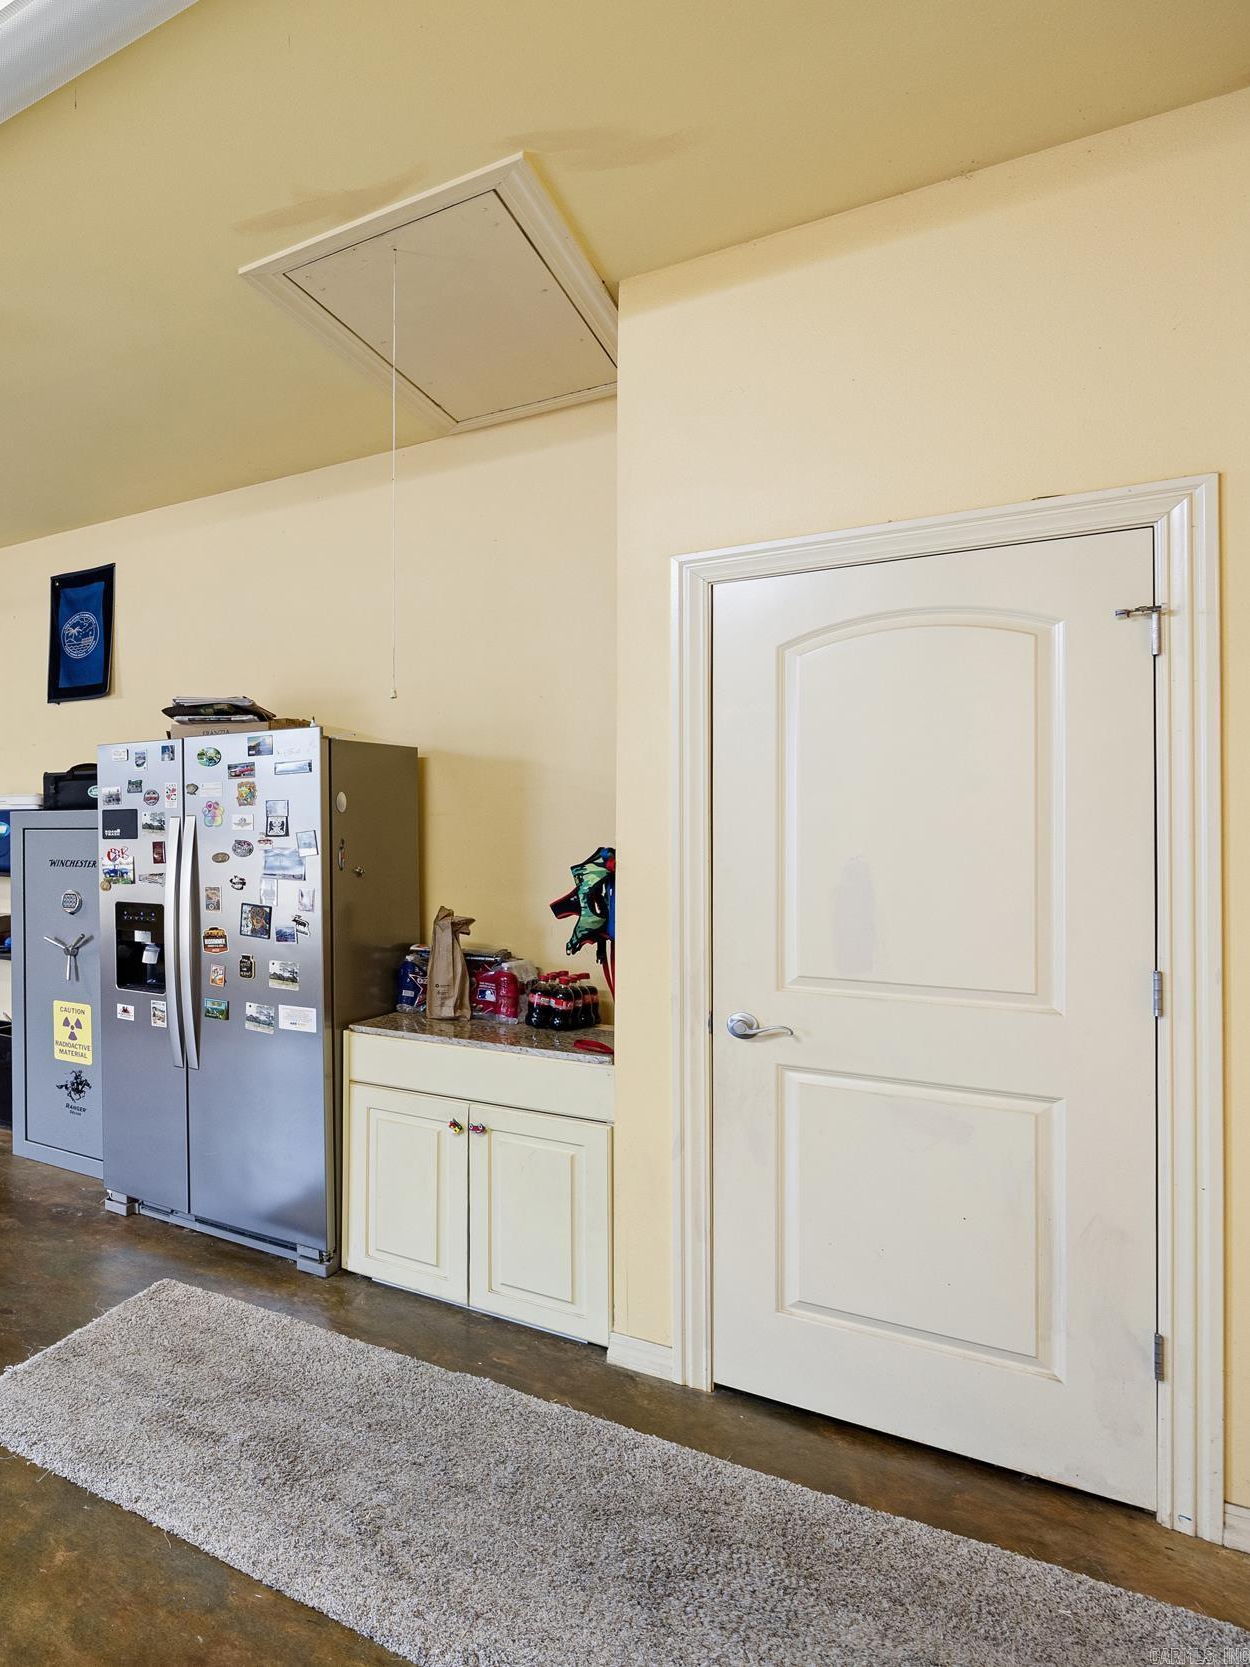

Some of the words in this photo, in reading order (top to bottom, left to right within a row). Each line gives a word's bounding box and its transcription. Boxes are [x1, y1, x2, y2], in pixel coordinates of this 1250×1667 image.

[48, 859, 97, 868] WINCHESTER
[59, 1006, 86, 1015] CAUTION
[55, 1040, 91, 1051] RADIOACTIVE
[59, 1048, 88, 1058] MATERIAL
